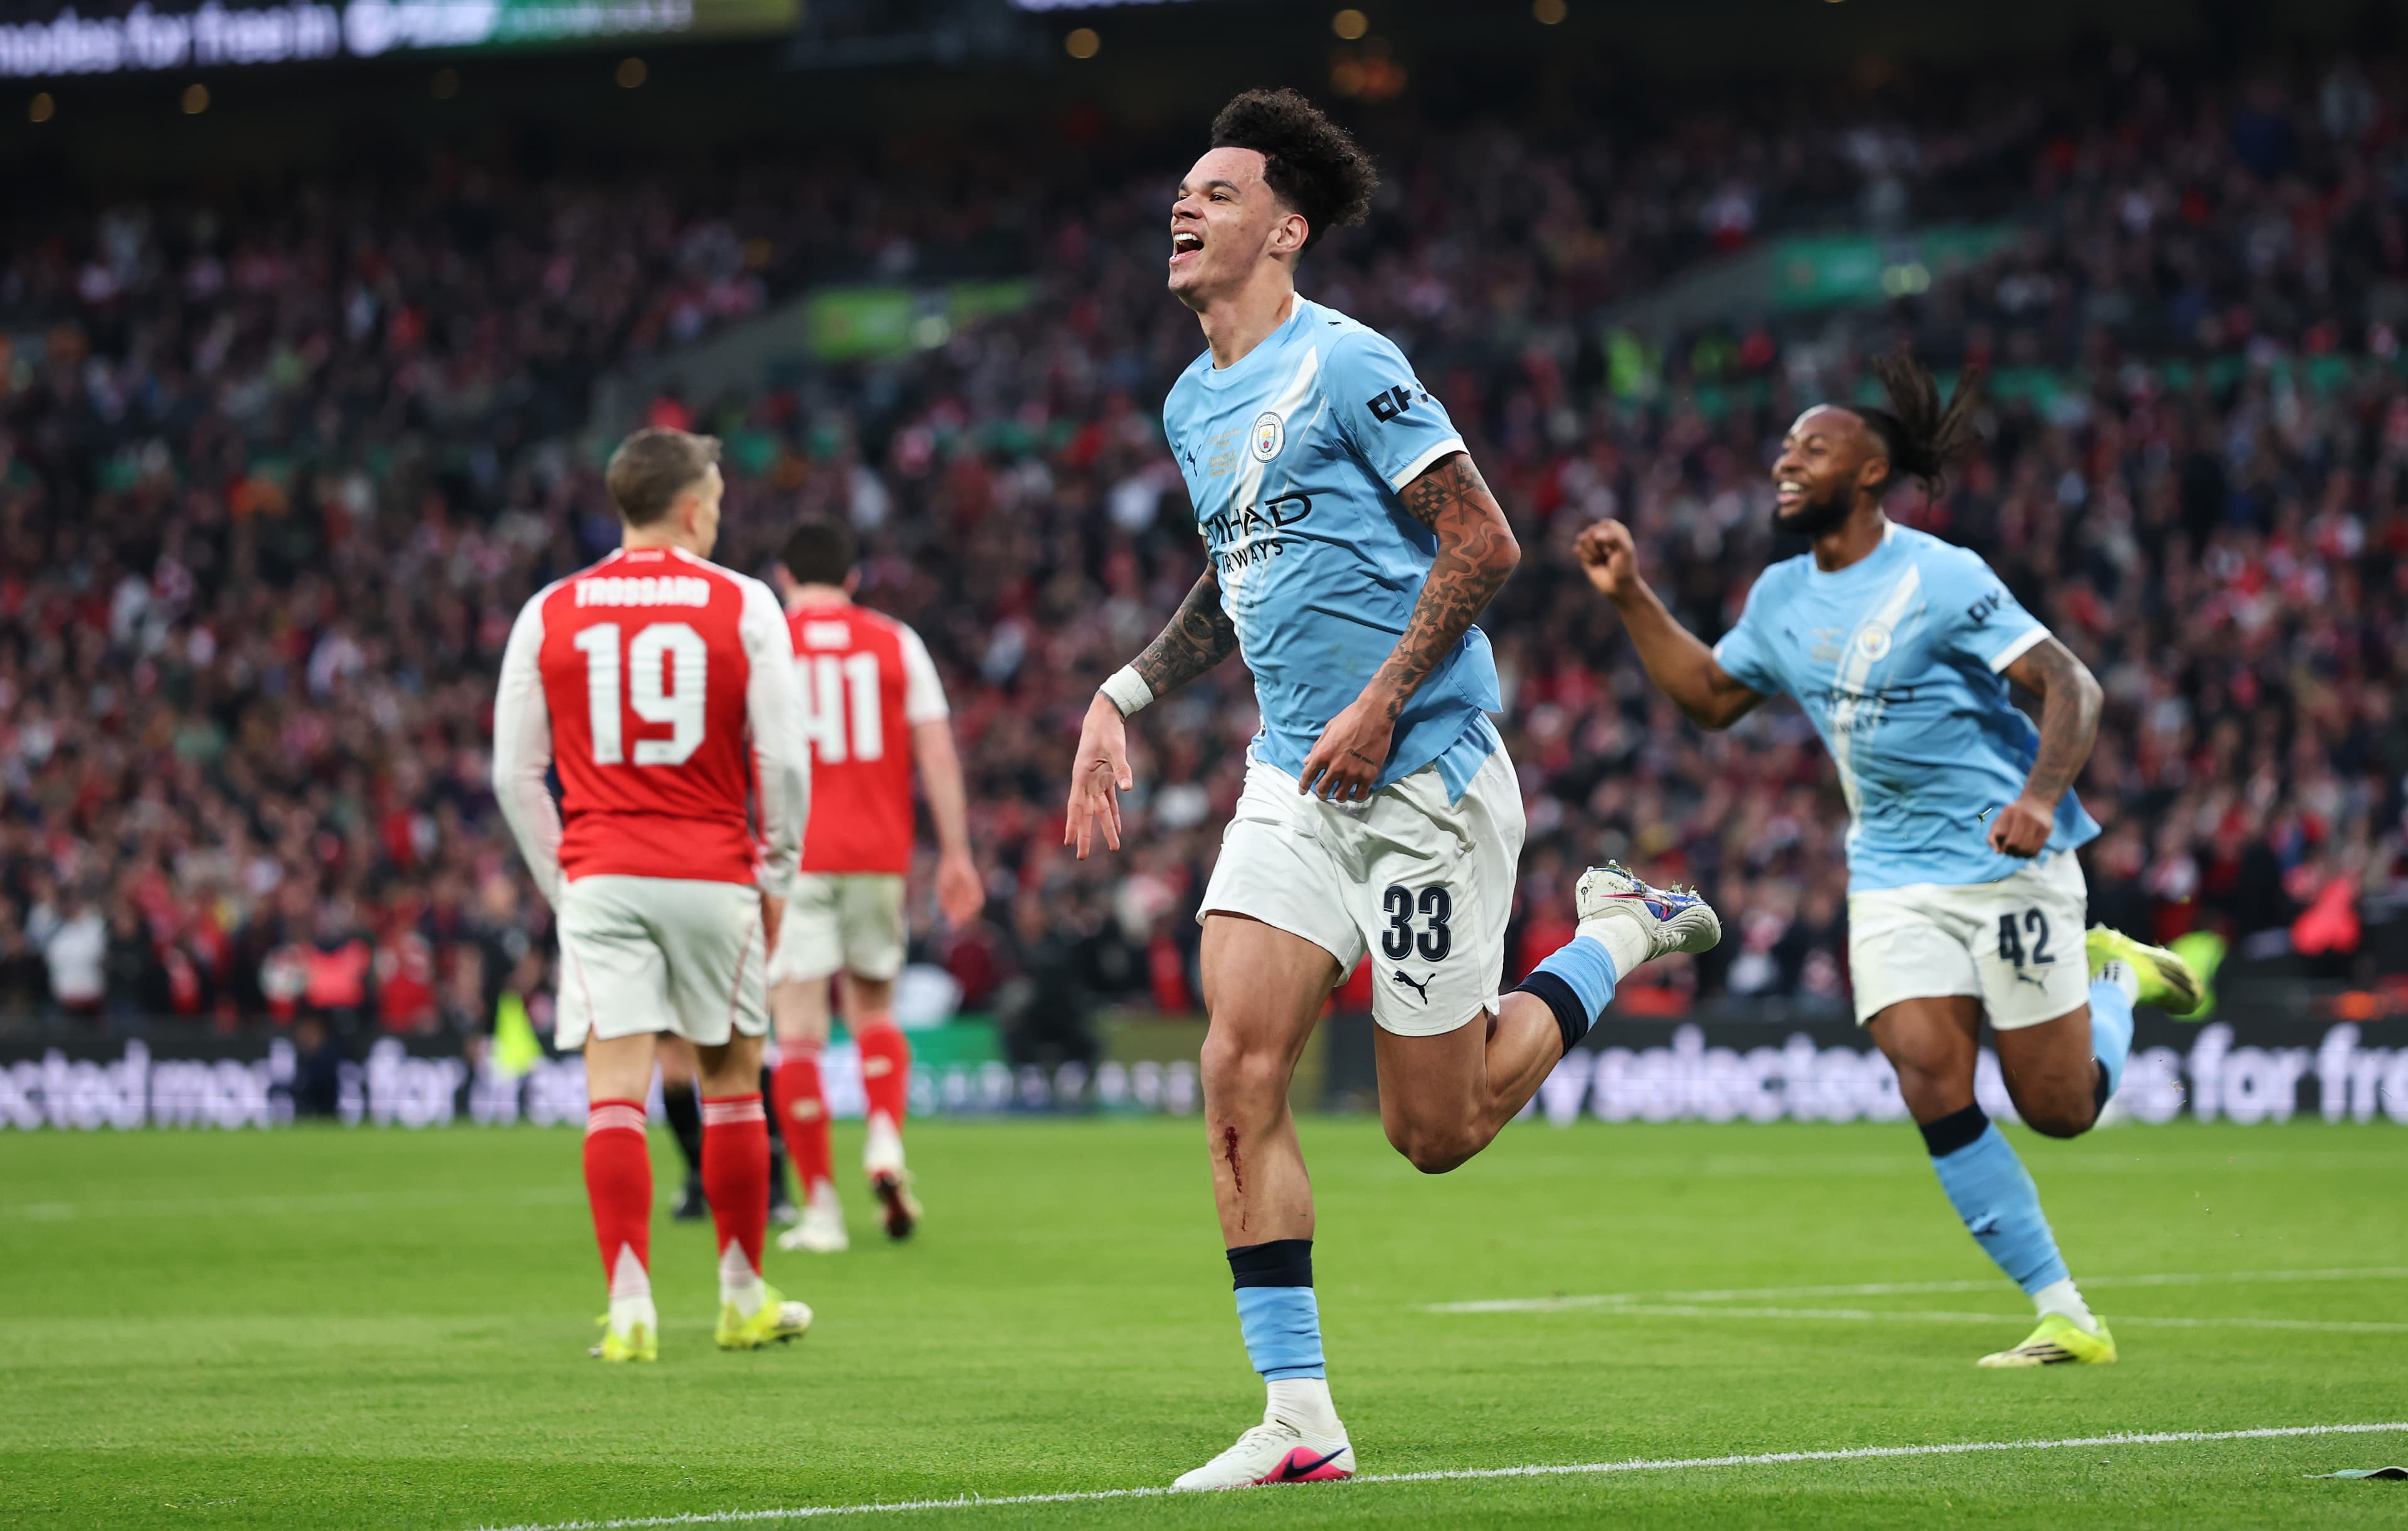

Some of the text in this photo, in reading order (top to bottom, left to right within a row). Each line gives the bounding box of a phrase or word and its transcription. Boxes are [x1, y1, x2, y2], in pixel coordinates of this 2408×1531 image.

[1203, 493, 1312, 549] TIHAD
[1222, 539, 1284, 574] IRWAYS
[574, 577, 710, 608] TROSSARD
[574, 622, 707, 767] 19
[794, 653, 884, 764] 41
[1381, 885, 1452, 962] 33
[1999, 907, 2056, 967] 42
[2191, 1020, 2311, 1126] for
